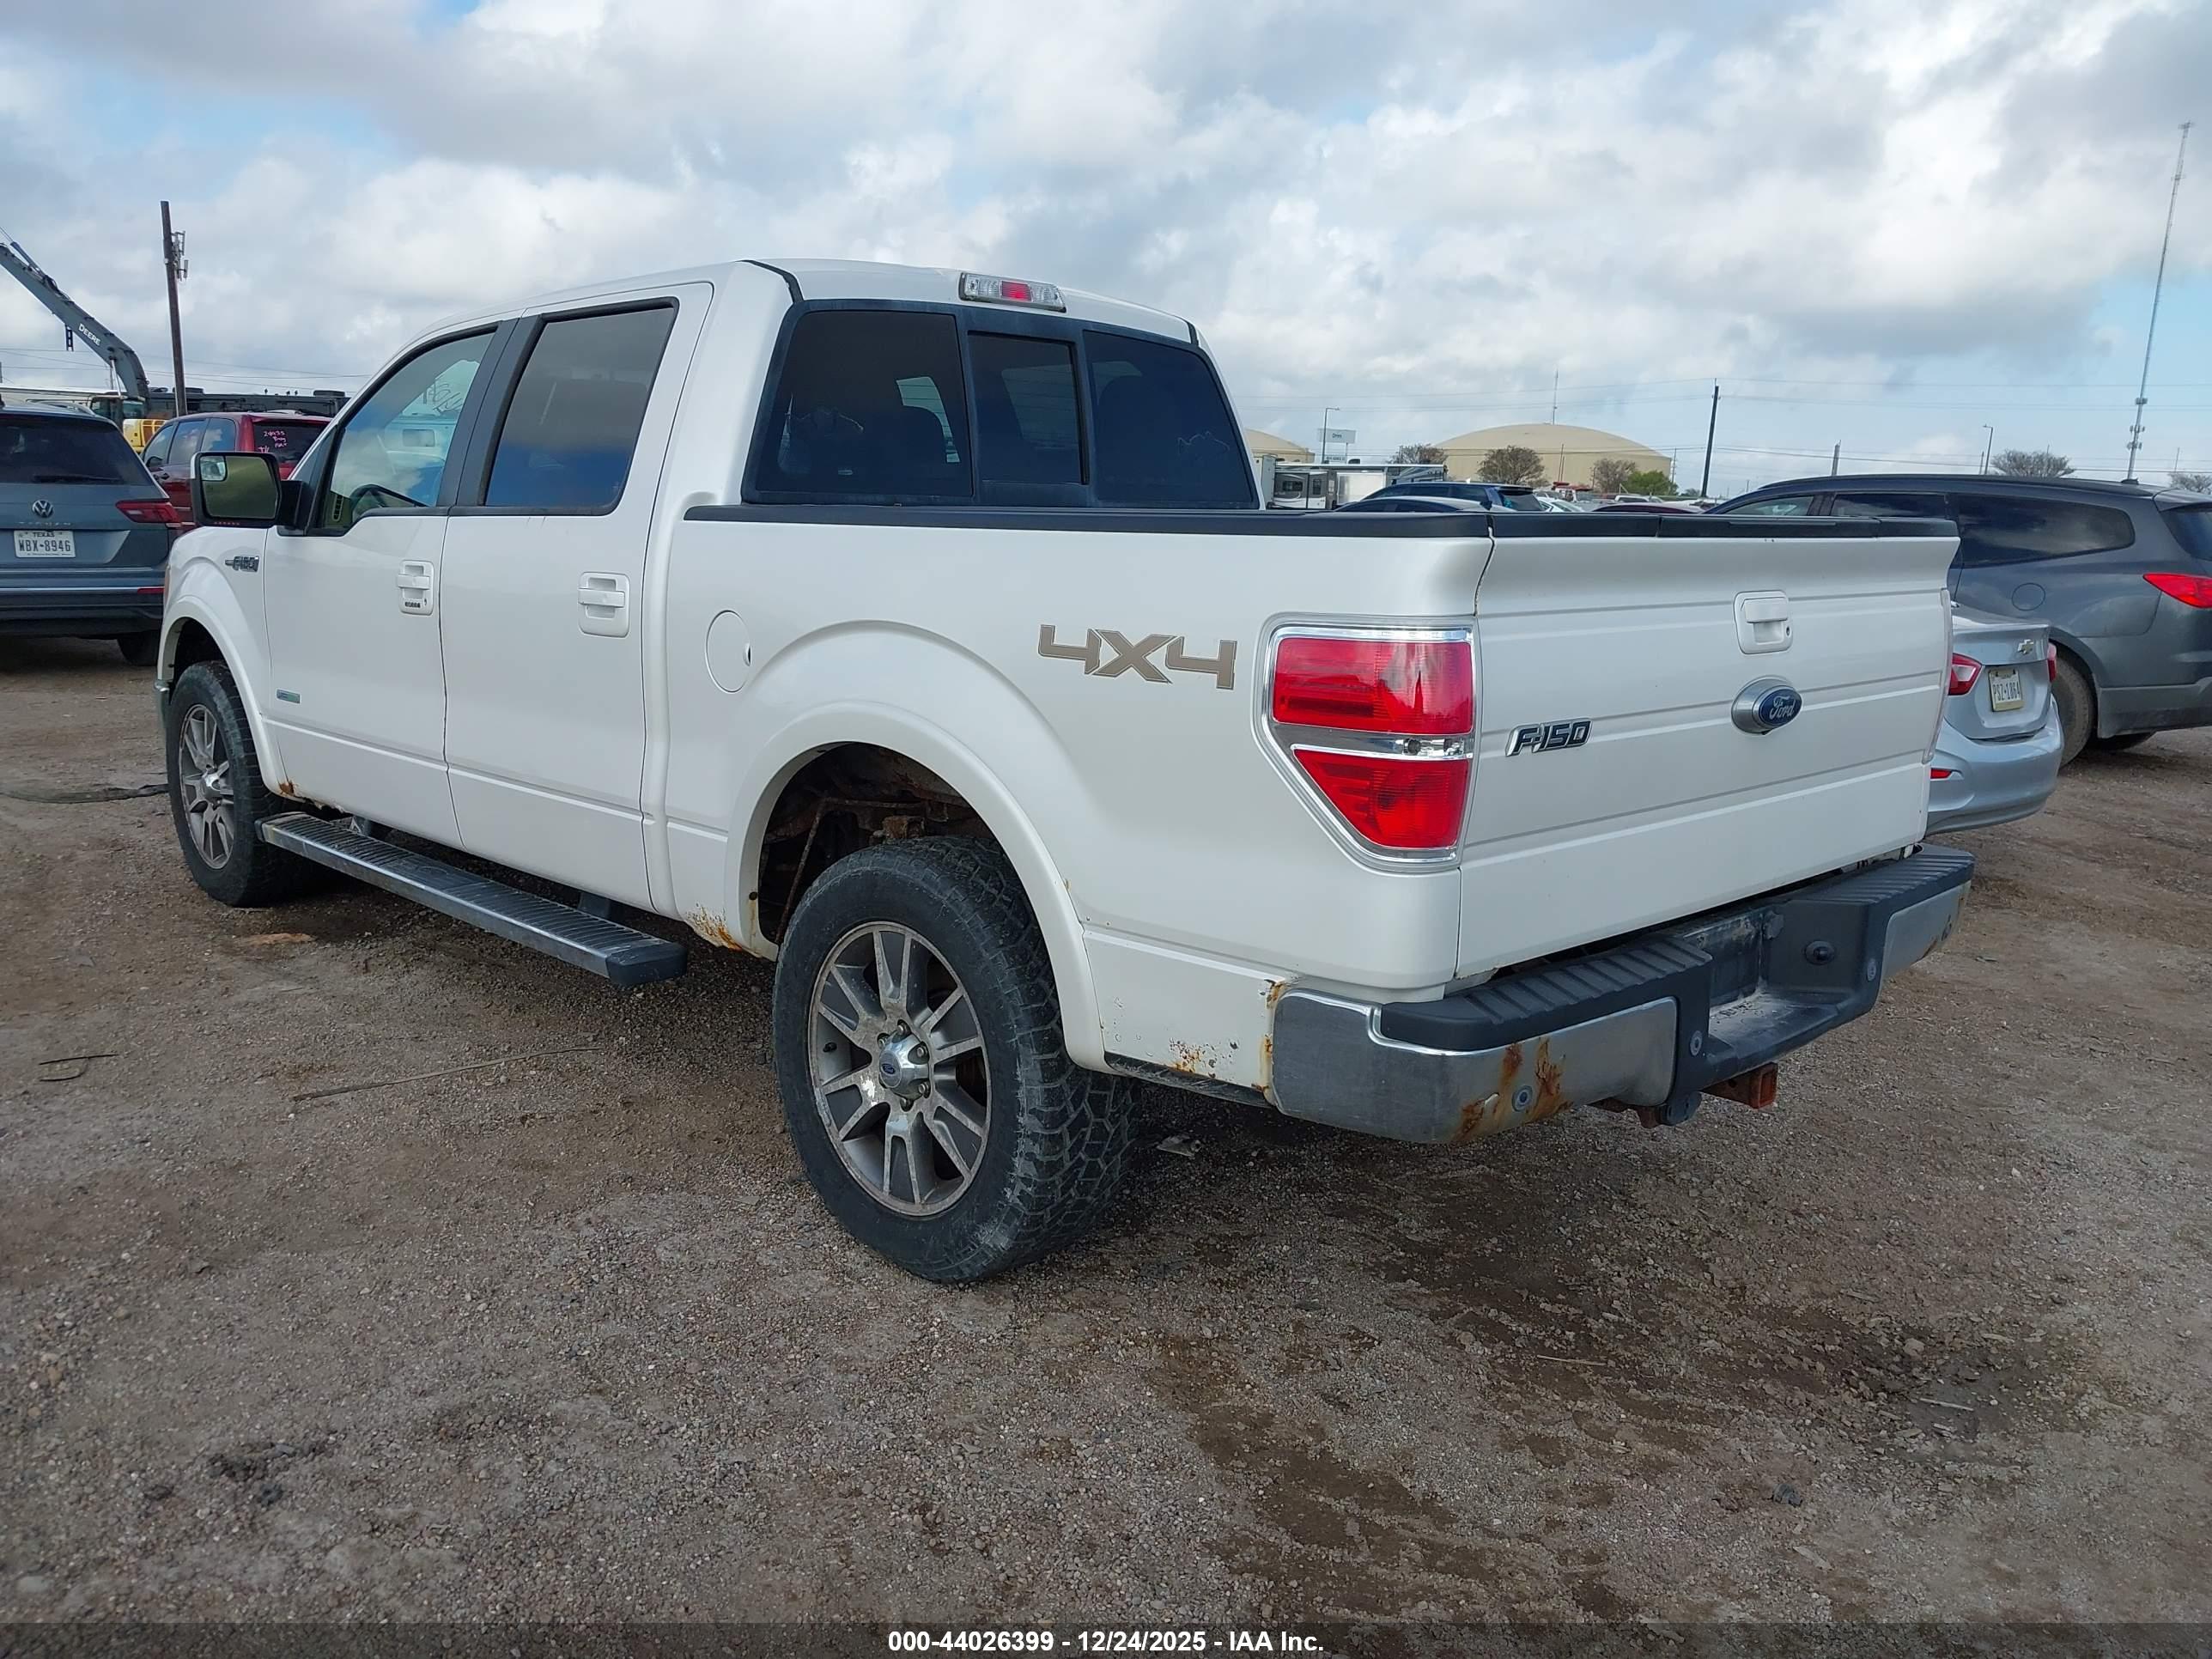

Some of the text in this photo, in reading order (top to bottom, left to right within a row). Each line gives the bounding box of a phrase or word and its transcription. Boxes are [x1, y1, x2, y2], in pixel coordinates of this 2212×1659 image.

[1038, 624, 1237, 690] 4X4
[1769, 696, 1796, 720] Ford
[1505, 718, 1592, 757] F-150
